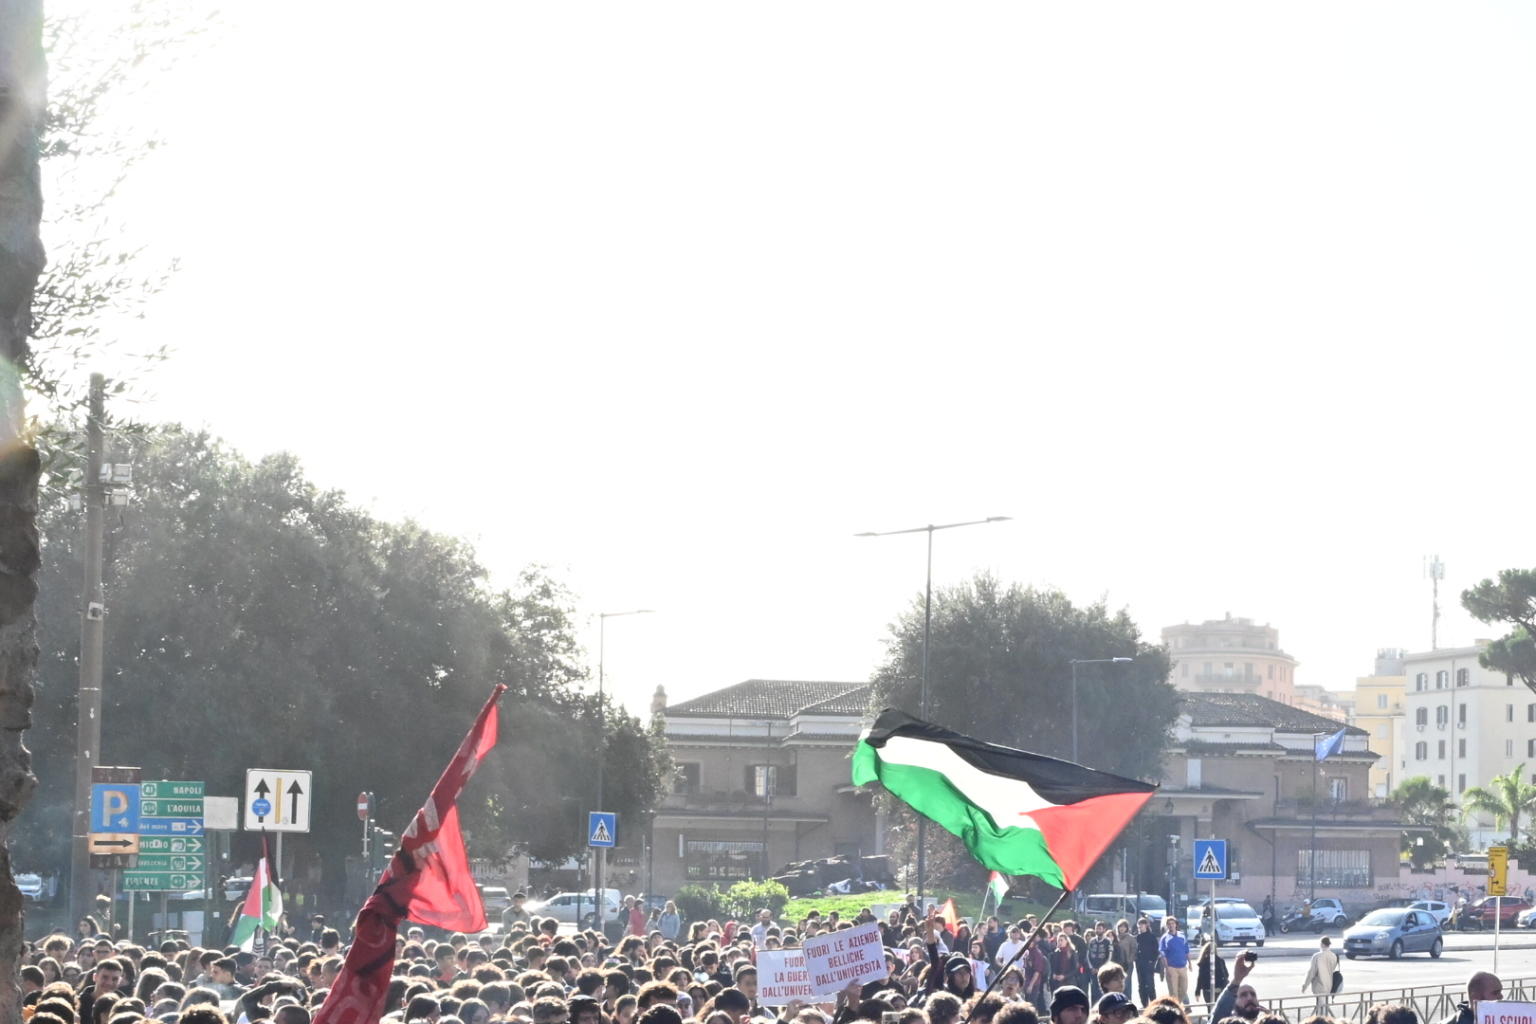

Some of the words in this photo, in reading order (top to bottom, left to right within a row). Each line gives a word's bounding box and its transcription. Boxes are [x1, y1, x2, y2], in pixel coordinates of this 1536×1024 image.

[102, 791, 128, 827] P
[168, 804, 201, 812] L'AQUILA
[807, 943, 830, 959] FUORI
[834, 940, 844, 952] LE
[848, 931, 879, 948] AZIENDE
[784, 957, 804, 967] FUOR
[828, 950, 864, 969] BELLICHE
[775, 972, 784, 983] LA
[788, 971, 808, 981] GUER
[762, 984, 813, 997] DALL'UNIVER
